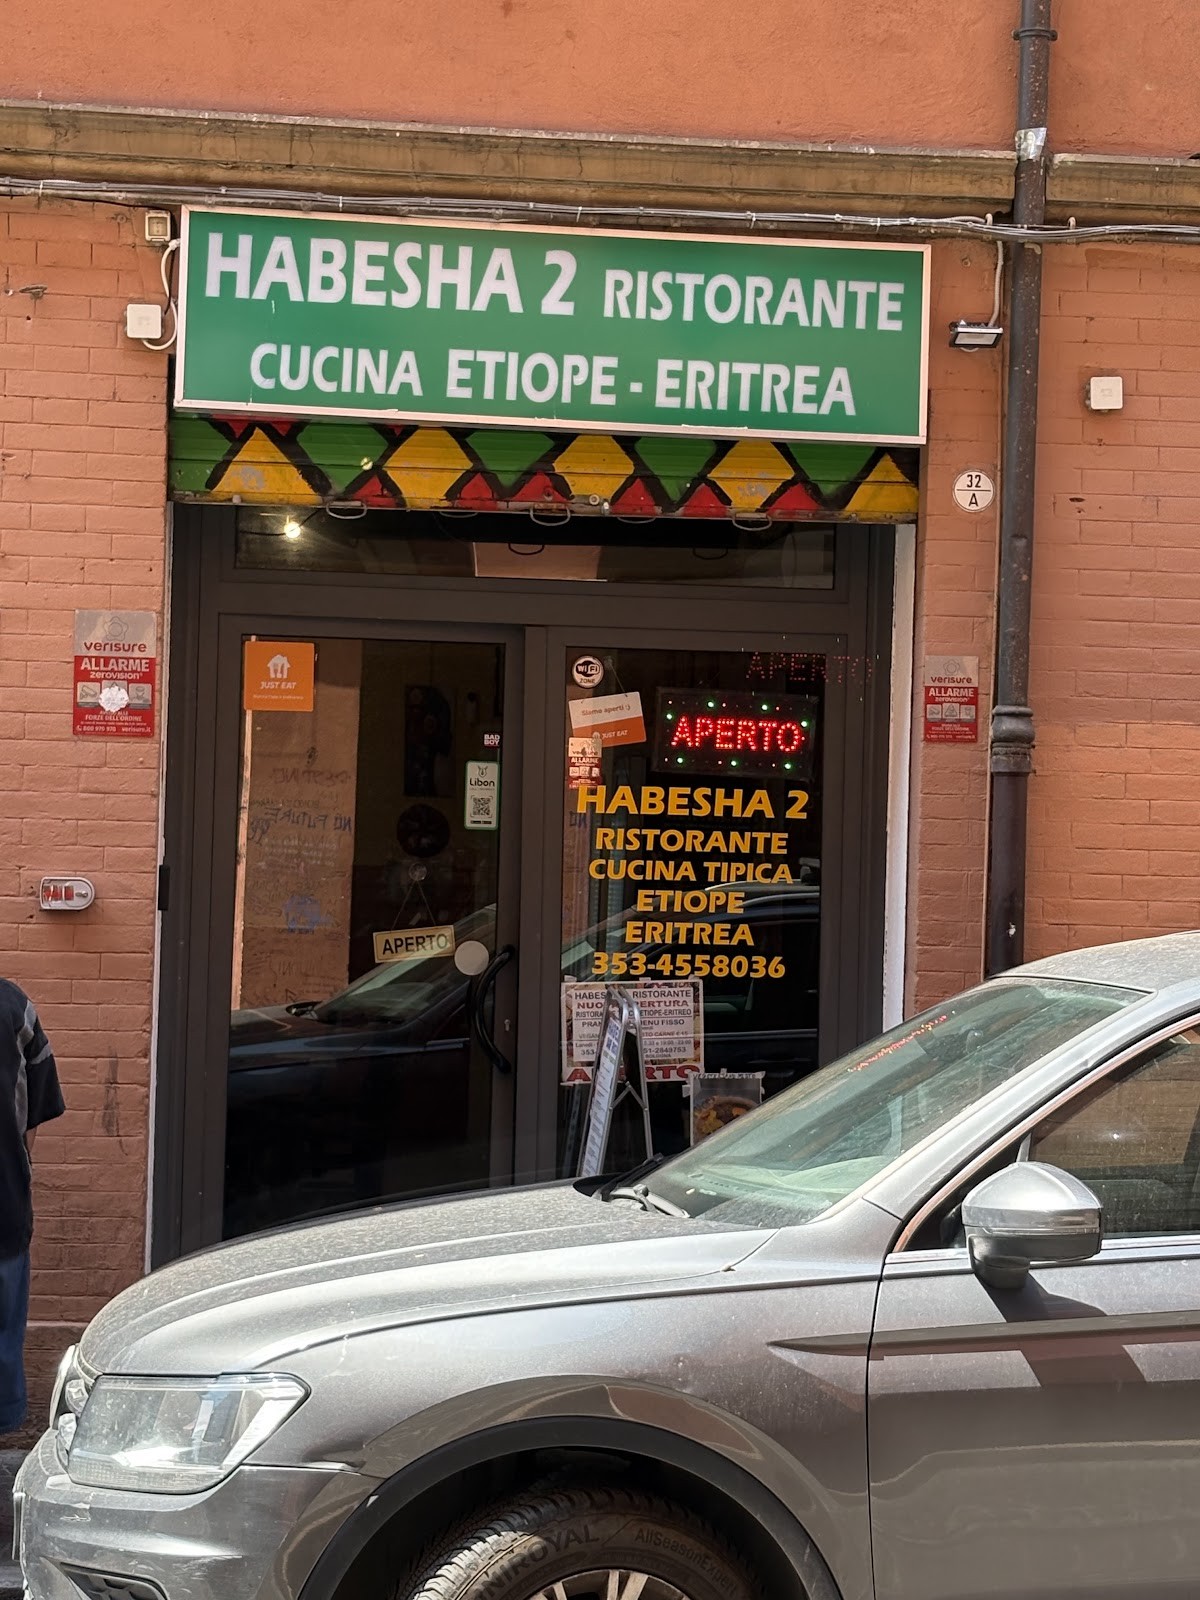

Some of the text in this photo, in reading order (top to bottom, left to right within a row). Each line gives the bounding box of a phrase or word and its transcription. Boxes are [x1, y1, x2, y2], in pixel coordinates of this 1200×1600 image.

[205, 232, 905, 331] HABESHA 2 RISTORANTE
[250, 342, 857, 416] CUCINA ETIOPE - ERITREA
[966, 474, 982, 488] 32
[968, 493, 979, 507] A
[84, 641, 148, 653] verisure
[80, 657, 150, 672] ALLARME
[260, 681, 297, 690] JUST EAT
[930, 676, 973, 684] verisure
[928, 687, 975, 698] ALLARME
[483, 733, 500, 741] BAD
[601, 731, 616, 739] JUST
[670, 715, 803, 752] APERTO
[469, 777, 496, 788] Libon
[576, 785, 810, 820] HABESHA 2
[595, 827, 789, 855] RISTORANTE
[588, 858, 794, 885] CUCINA TIPICA
[636, 889, 746, 915] ETIOPE
[624, 921, 755, 946] ERITREA
[382, 933, 449, 956] APERTO
[591, 952, 787, 979] 353-4558036
[632, 989, 692, 999] RISTORANTE
[635, 1000, 690, 1009] ERTURA
